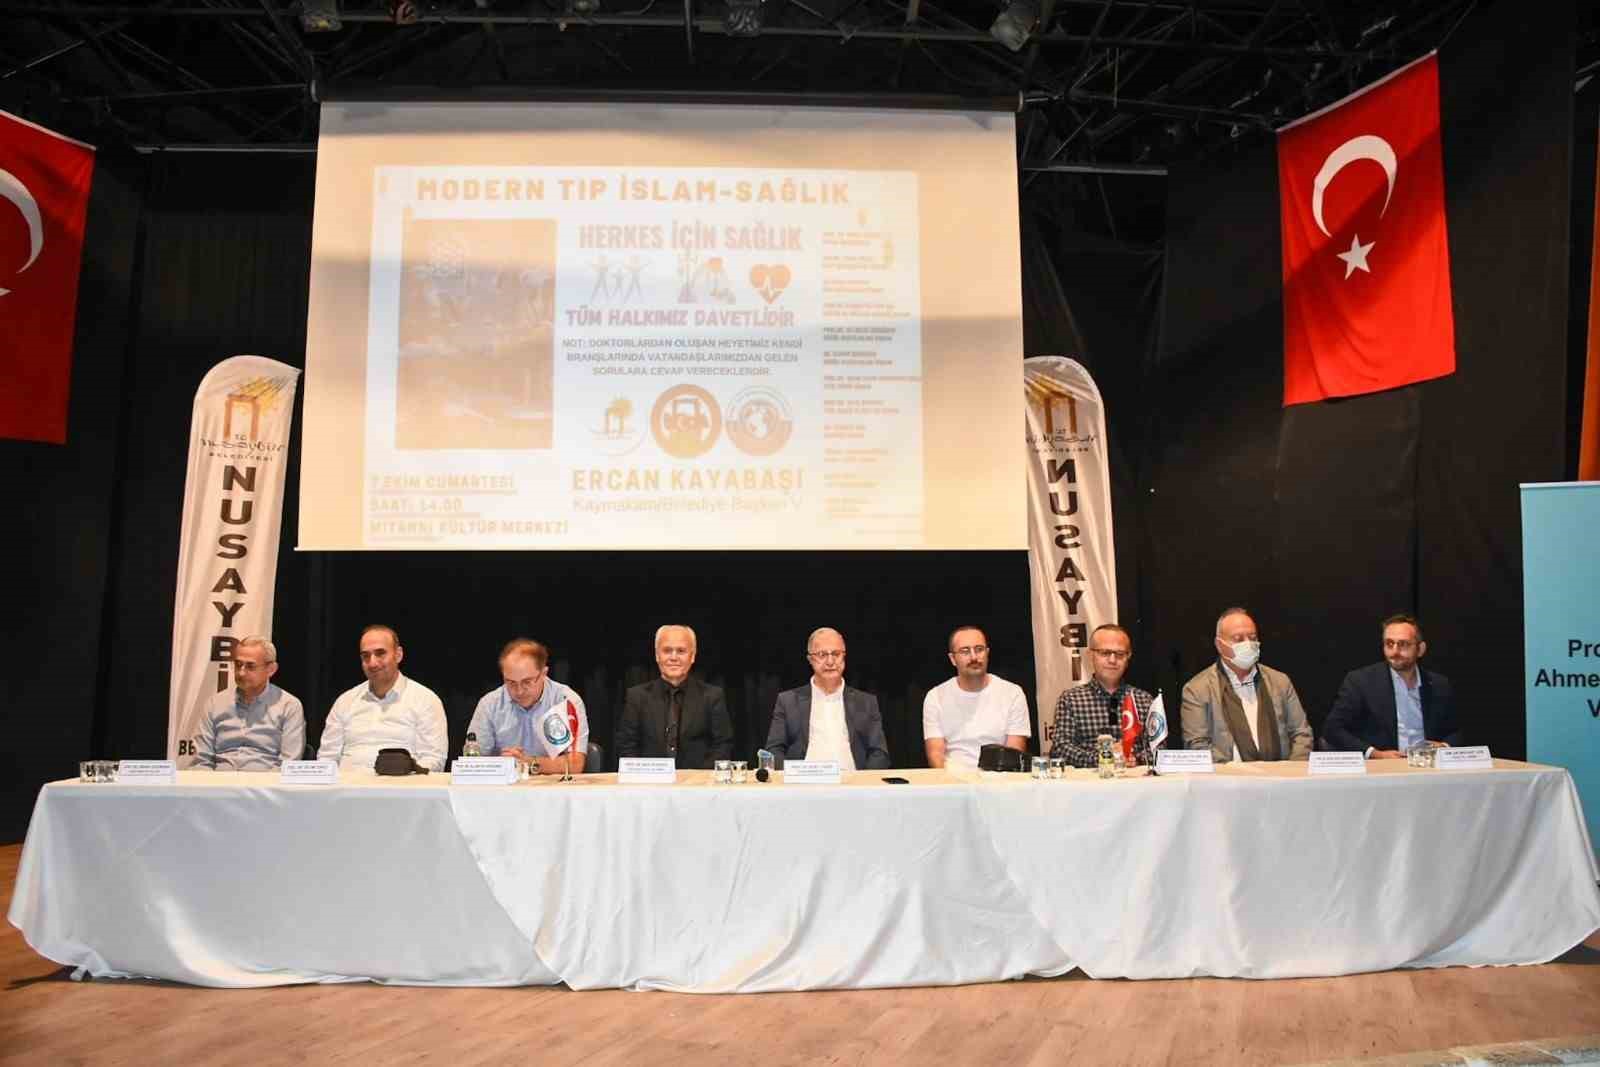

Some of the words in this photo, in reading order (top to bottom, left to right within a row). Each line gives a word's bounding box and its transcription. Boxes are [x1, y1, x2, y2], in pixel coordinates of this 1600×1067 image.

[416, 178, 545, 201] MODERN
[559, 179, 608, 201] TIP
[619, 174, 849, 204] İSLAM-SAĞLIK
[578, 224, 664, 249] HERKES
[672, 219, 716, 254] İÇİN
[725, 221, 802, 251] SAĞLIK
[566, 306, 603, 327] TÜM
[608, 308, 688, 327] HALKIMIZ
[694, 306, 794, 328] DAVETLİDİR
[591, 338, 672, 348] DOKTORLARDAN
[573, 469, 659, 490] ERCAN
[671, 467, 803, 495] KAYABAŞI
